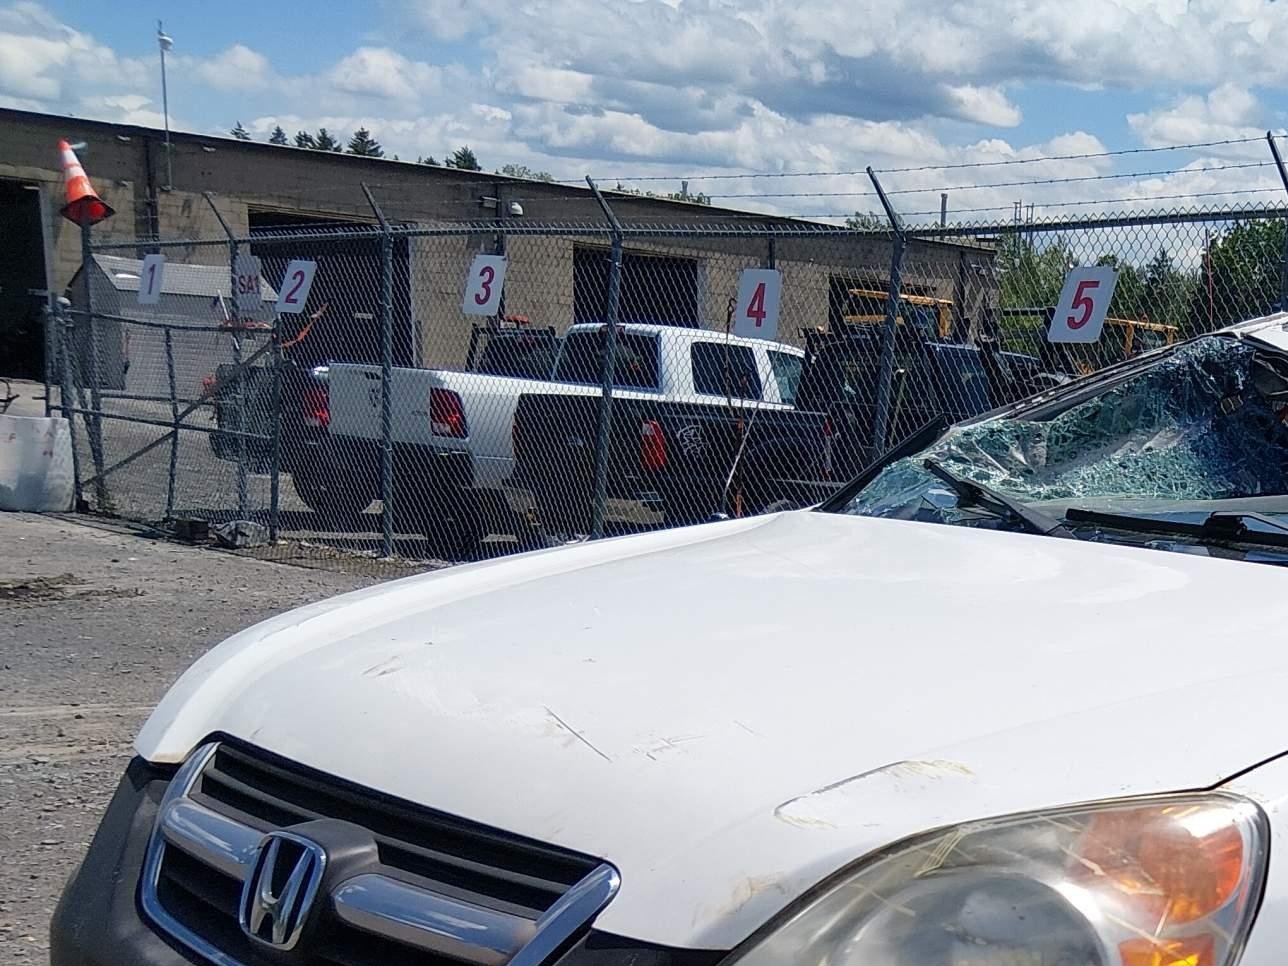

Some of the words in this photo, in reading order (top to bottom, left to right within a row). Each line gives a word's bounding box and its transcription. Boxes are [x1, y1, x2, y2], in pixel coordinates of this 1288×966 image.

[148, 263, 156, 295] 1
[285, 270, 305, 304] 2
[474, 266, 495, 305] 3
[747, 282, 767, 328] 4
[1066, 280, 1100, 330] 5
